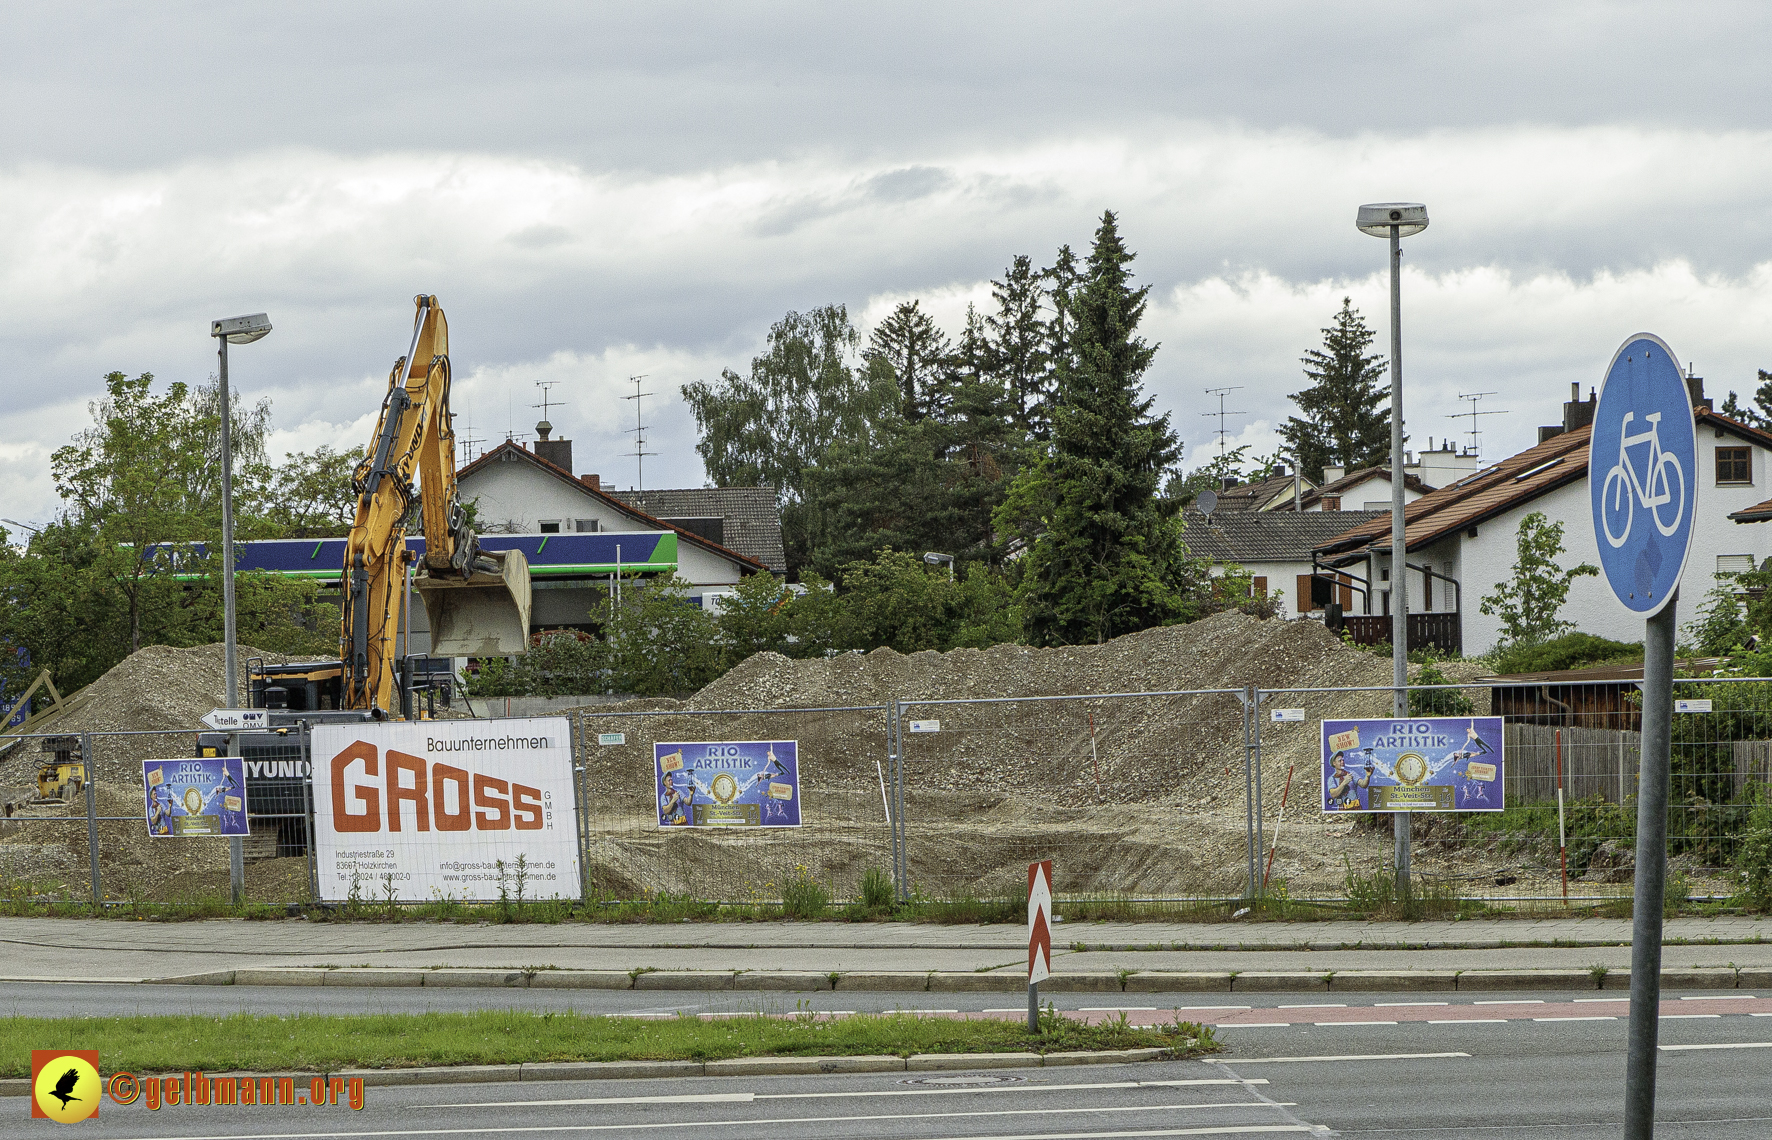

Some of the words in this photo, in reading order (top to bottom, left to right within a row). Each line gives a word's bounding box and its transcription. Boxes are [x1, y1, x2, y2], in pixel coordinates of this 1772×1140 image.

[1391, 722, 1432, 735] RIO
[427, 734, 548, 752] Bauunternehmen
[1335, 739, 1356, 750] SHOW!
[1374, 735, 1448, 748] ARTISTIK
[708, 746, 739, 757] RIO
[180, 762, 203, 773] RIO
[244, 760, 312, 778] YUND
[695, 758, 753, 769] ARTISTIK
[171, 773, 213, 785] ARTISTIK
[330, 739, 544, 833] GROSS
[1393, 785, 1431, 793] München
[1390, 792, 1434, 800] St.-Veit-Str.
[335, 849, 385, 859] Industriestraße
[385, 849, 395, 859] 29
[358, 860, 398, 870] Holzkirchen
[439, 860, 556, 872] info@gross-baunternmen.de
[442, 872, 557, 883] www.gross-baunternhmen.de
